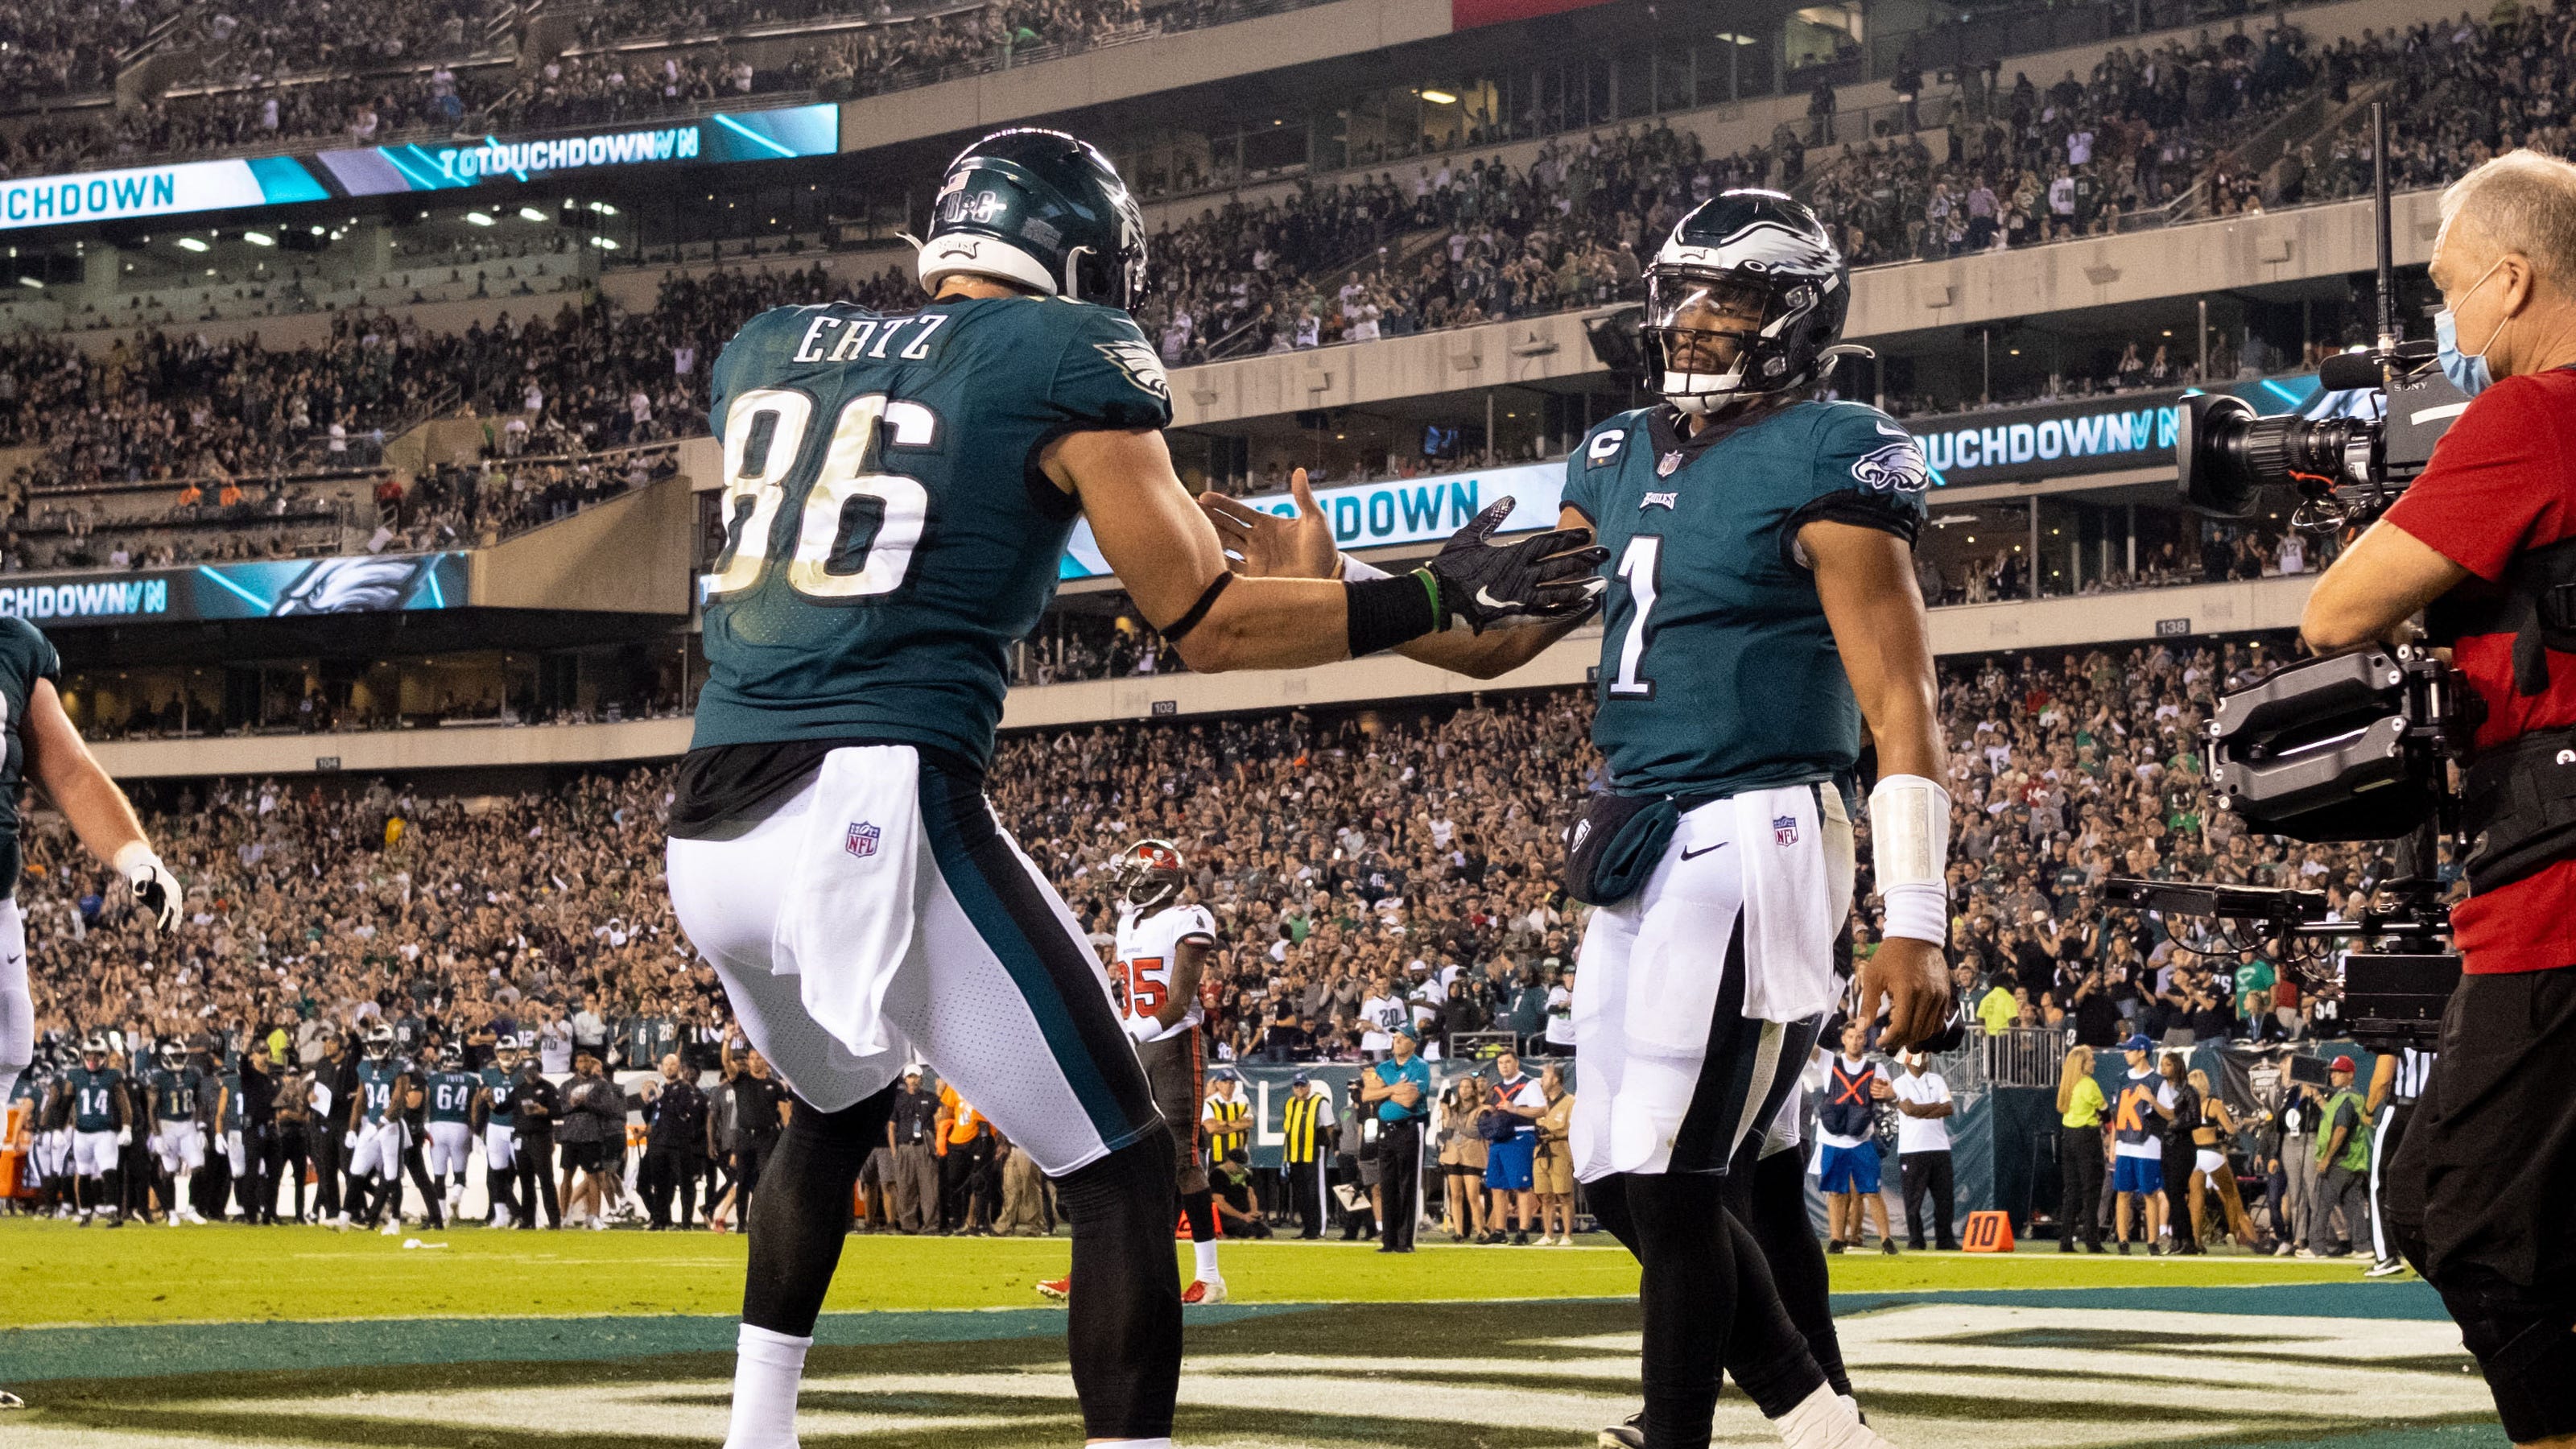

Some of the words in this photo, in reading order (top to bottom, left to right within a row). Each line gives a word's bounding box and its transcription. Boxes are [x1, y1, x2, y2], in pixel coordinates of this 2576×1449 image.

[0, 173, 174, 220] CHDOWN
[1589, 429, 1624, 459] C
[707, 389, 936, 597] 86
[1610, 535, 1662, 695] 1
[2161, 620, 2186, 634] 138
[1154, 702, 1174, 713] 102
[848, 836, 874, 854] NFL
[81, 1088, 109, 1115] 14
[437, 1084, 469, 1111] 64
[2116, 1088, 2143, 1131] K
[1970, 1216, 1999, 1246] 10
